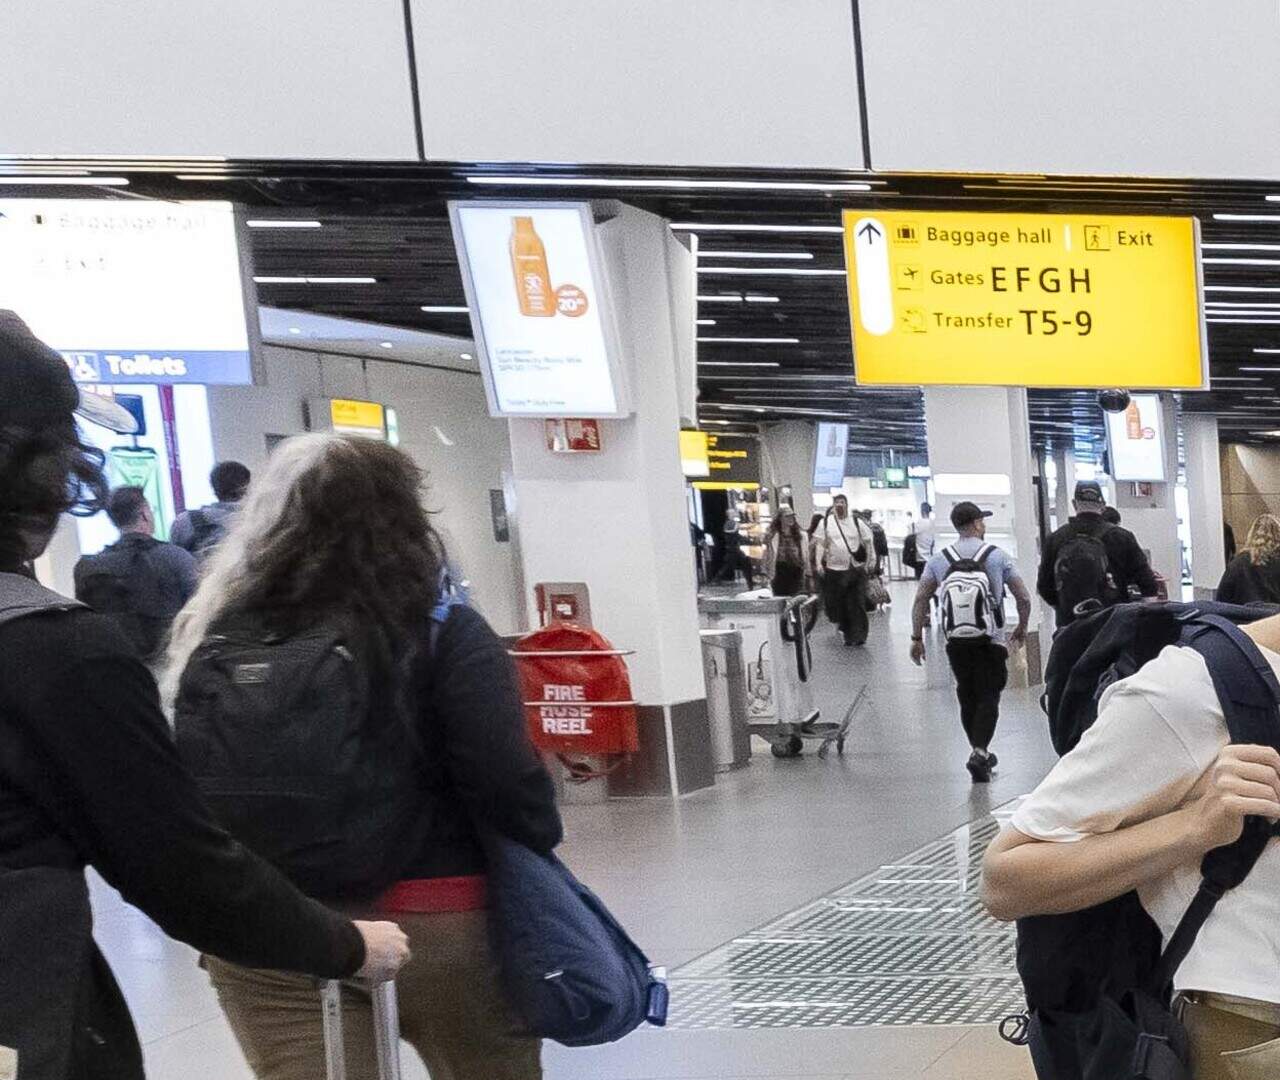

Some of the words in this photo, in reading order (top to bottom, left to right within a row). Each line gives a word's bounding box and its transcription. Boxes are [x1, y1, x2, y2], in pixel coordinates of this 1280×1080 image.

[927, 227, 1010, 246] Baggage
[1017, 227, 1052, 244] hall
[1117, 230, 1153, 246] Exit
[931, 270, 985, 285] Gates
[933, 312, 1013, 329] Transfer
[1019, 310, 1092, 336] T5-9
[104, 354, 187, 376] Toilets
[543, 684, 586, 701] FIRE
[542, 718, 593, 735] REEL
